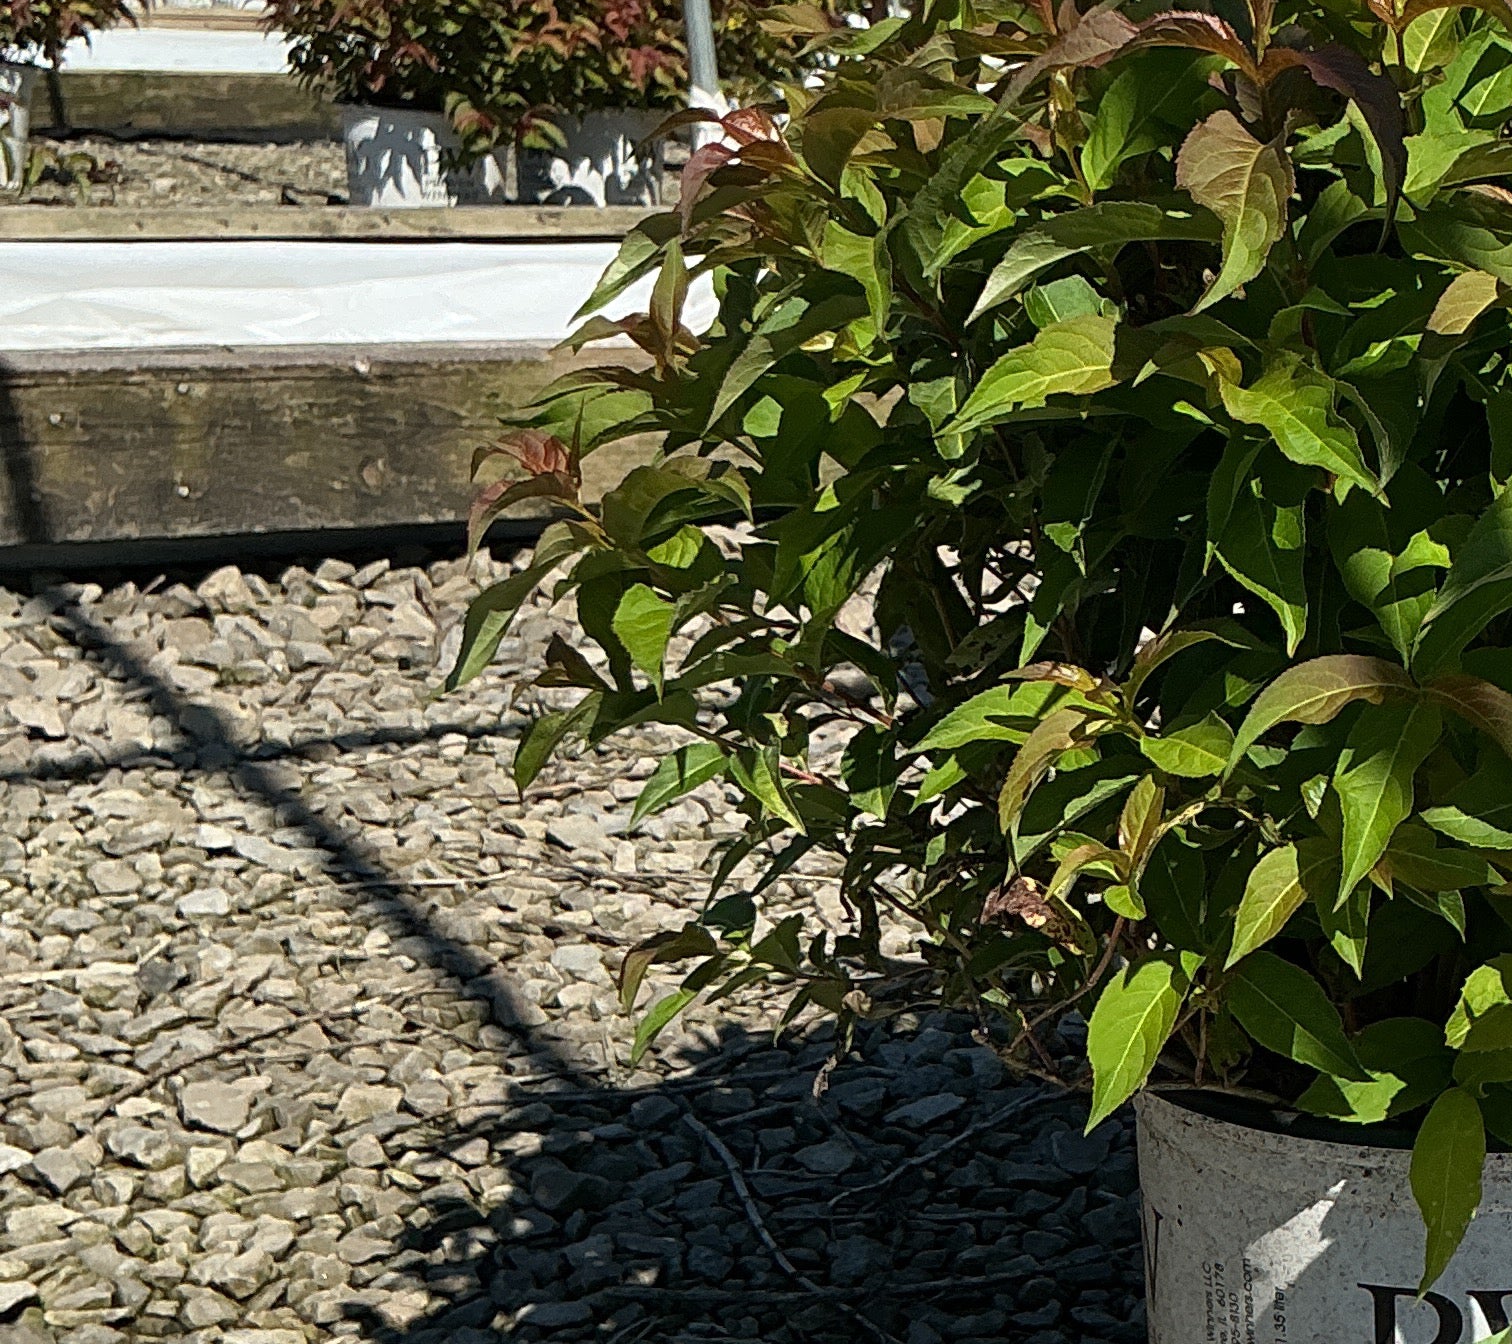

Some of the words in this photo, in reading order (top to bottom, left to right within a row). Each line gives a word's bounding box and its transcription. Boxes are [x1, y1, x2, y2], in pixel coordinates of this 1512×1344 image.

[1202, 1261, 1213, 1288] LLC
[1214, 1262, 1226, 1308] 60178
[1274, 1286, 1286, 1312] liter
